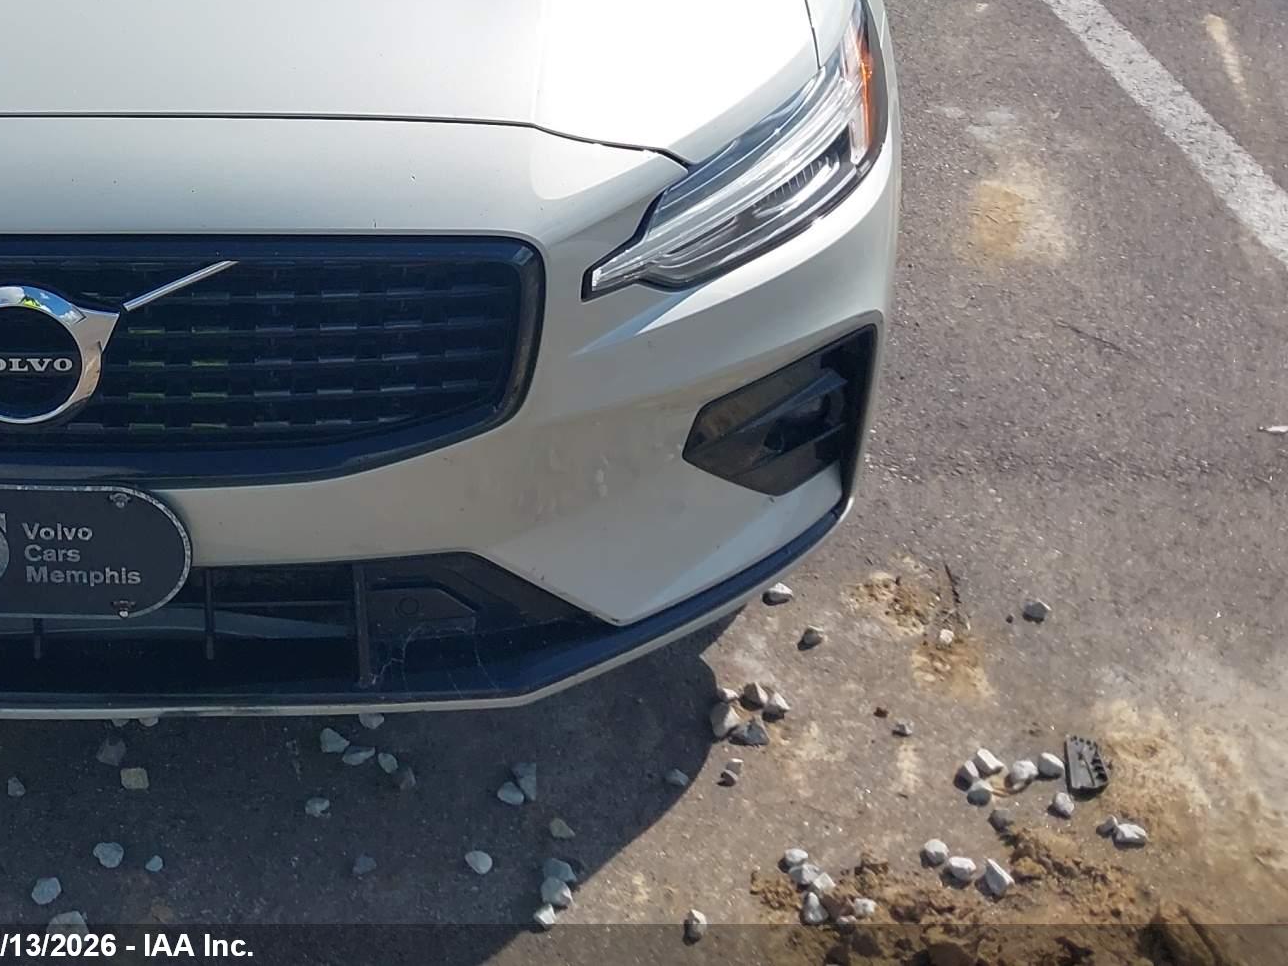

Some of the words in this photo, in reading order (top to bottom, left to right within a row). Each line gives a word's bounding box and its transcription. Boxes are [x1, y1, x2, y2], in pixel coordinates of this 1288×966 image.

[22, 522, 93, 541] Volvo
[24, 544, 81, 563] Cars
[26, 565, 142, 588] Memphis
